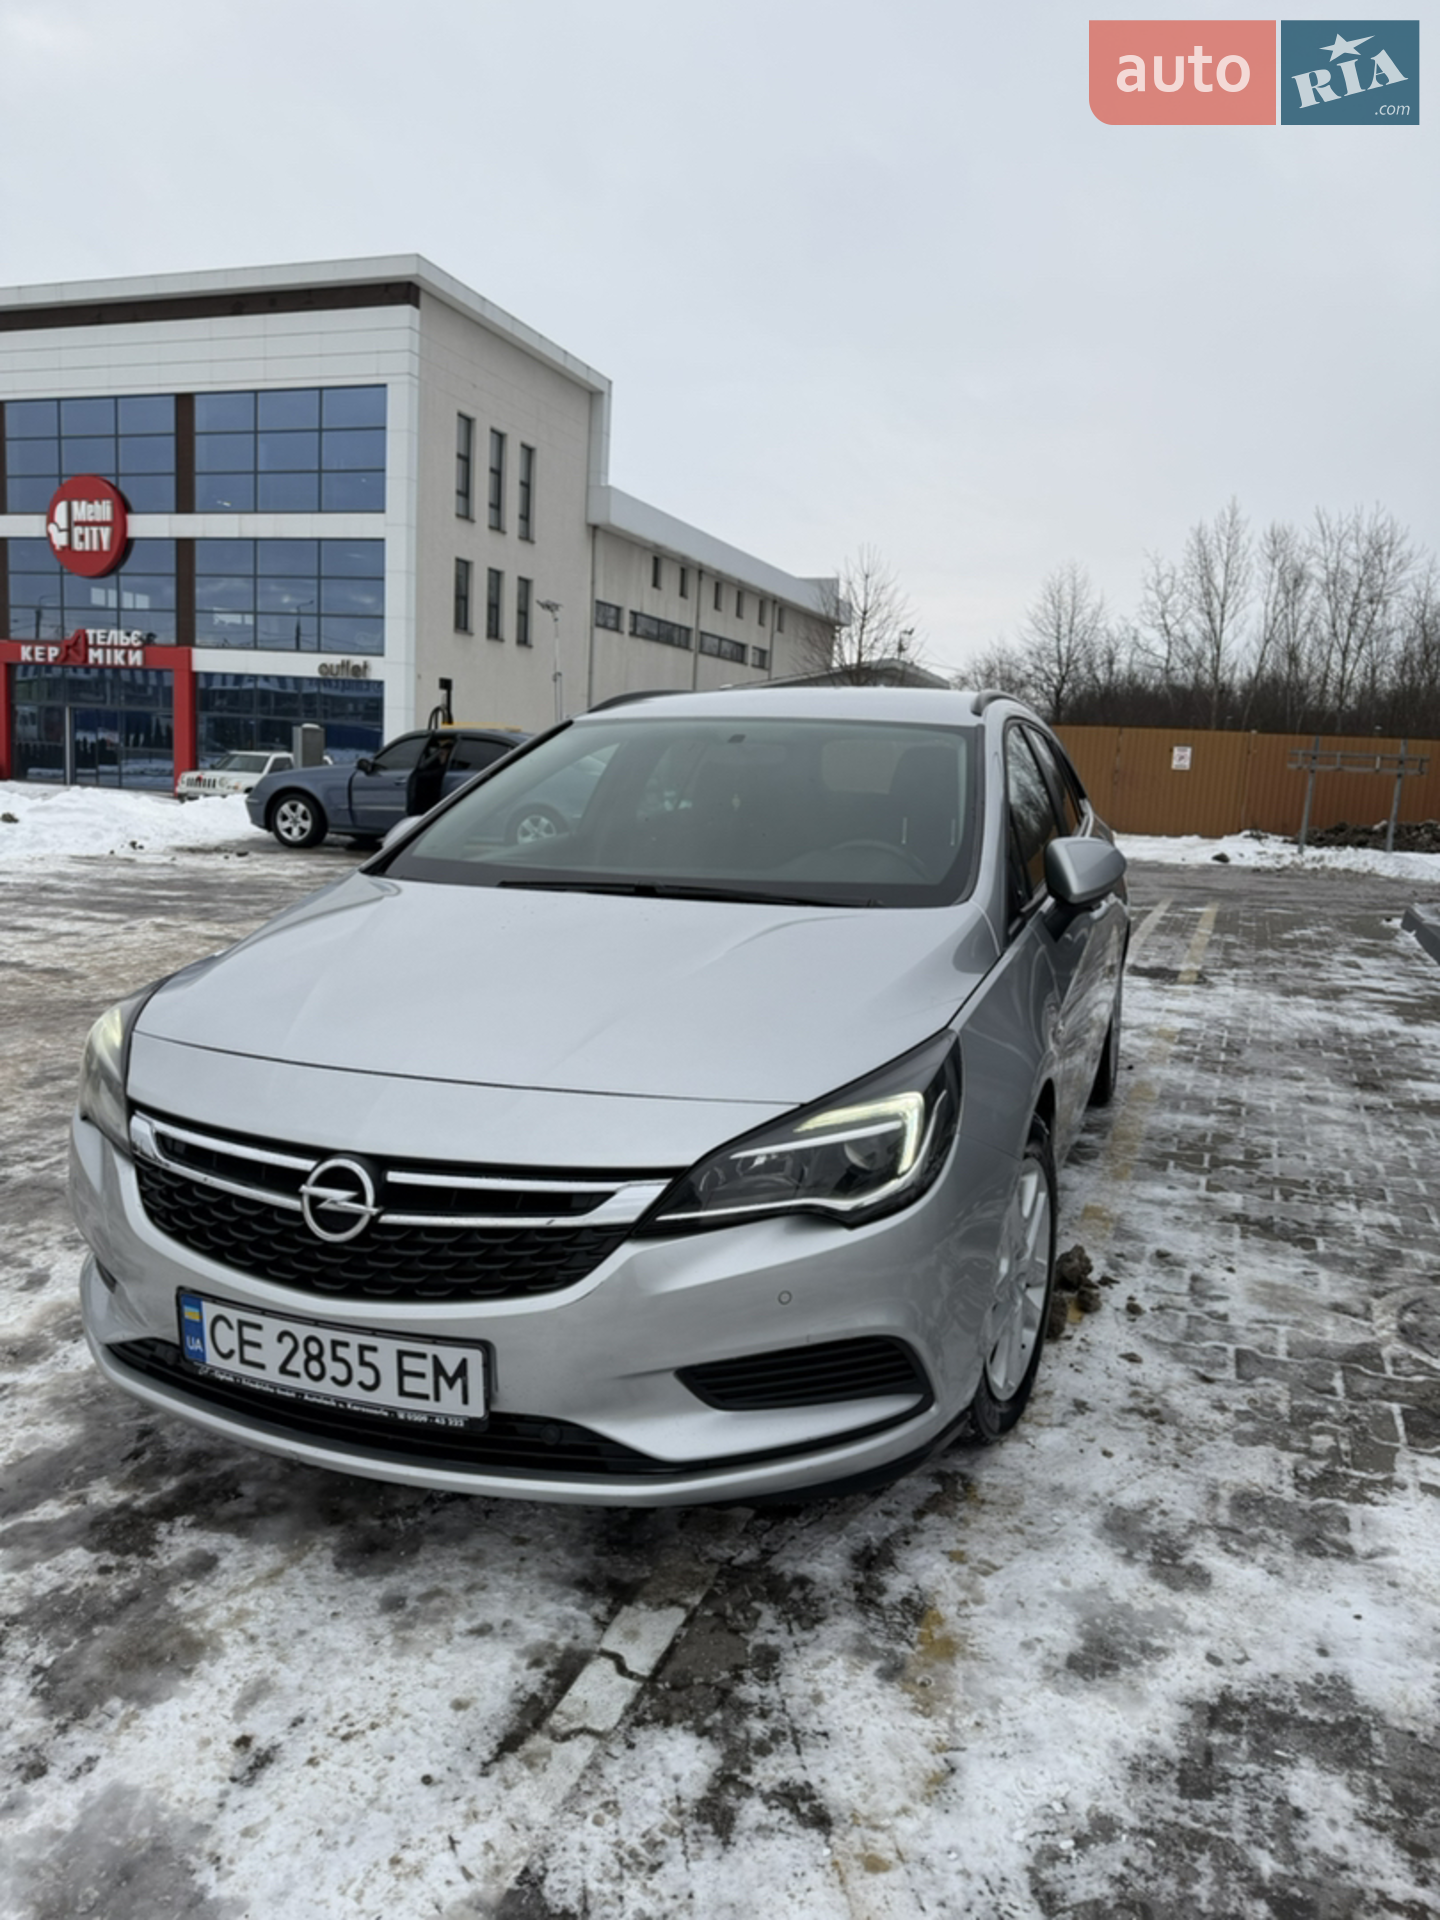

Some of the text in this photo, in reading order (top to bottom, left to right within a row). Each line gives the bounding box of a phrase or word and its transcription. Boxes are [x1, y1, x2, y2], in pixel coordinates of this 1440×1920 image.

[72, 499, 113, 522] Mebli
[72, 526, 112, 552] CITY
[318, 659, 370, 678] outlet
[185, 1335, 203, 1352] UA
[210, 1313, 469, 1406] CE 2855 EM
